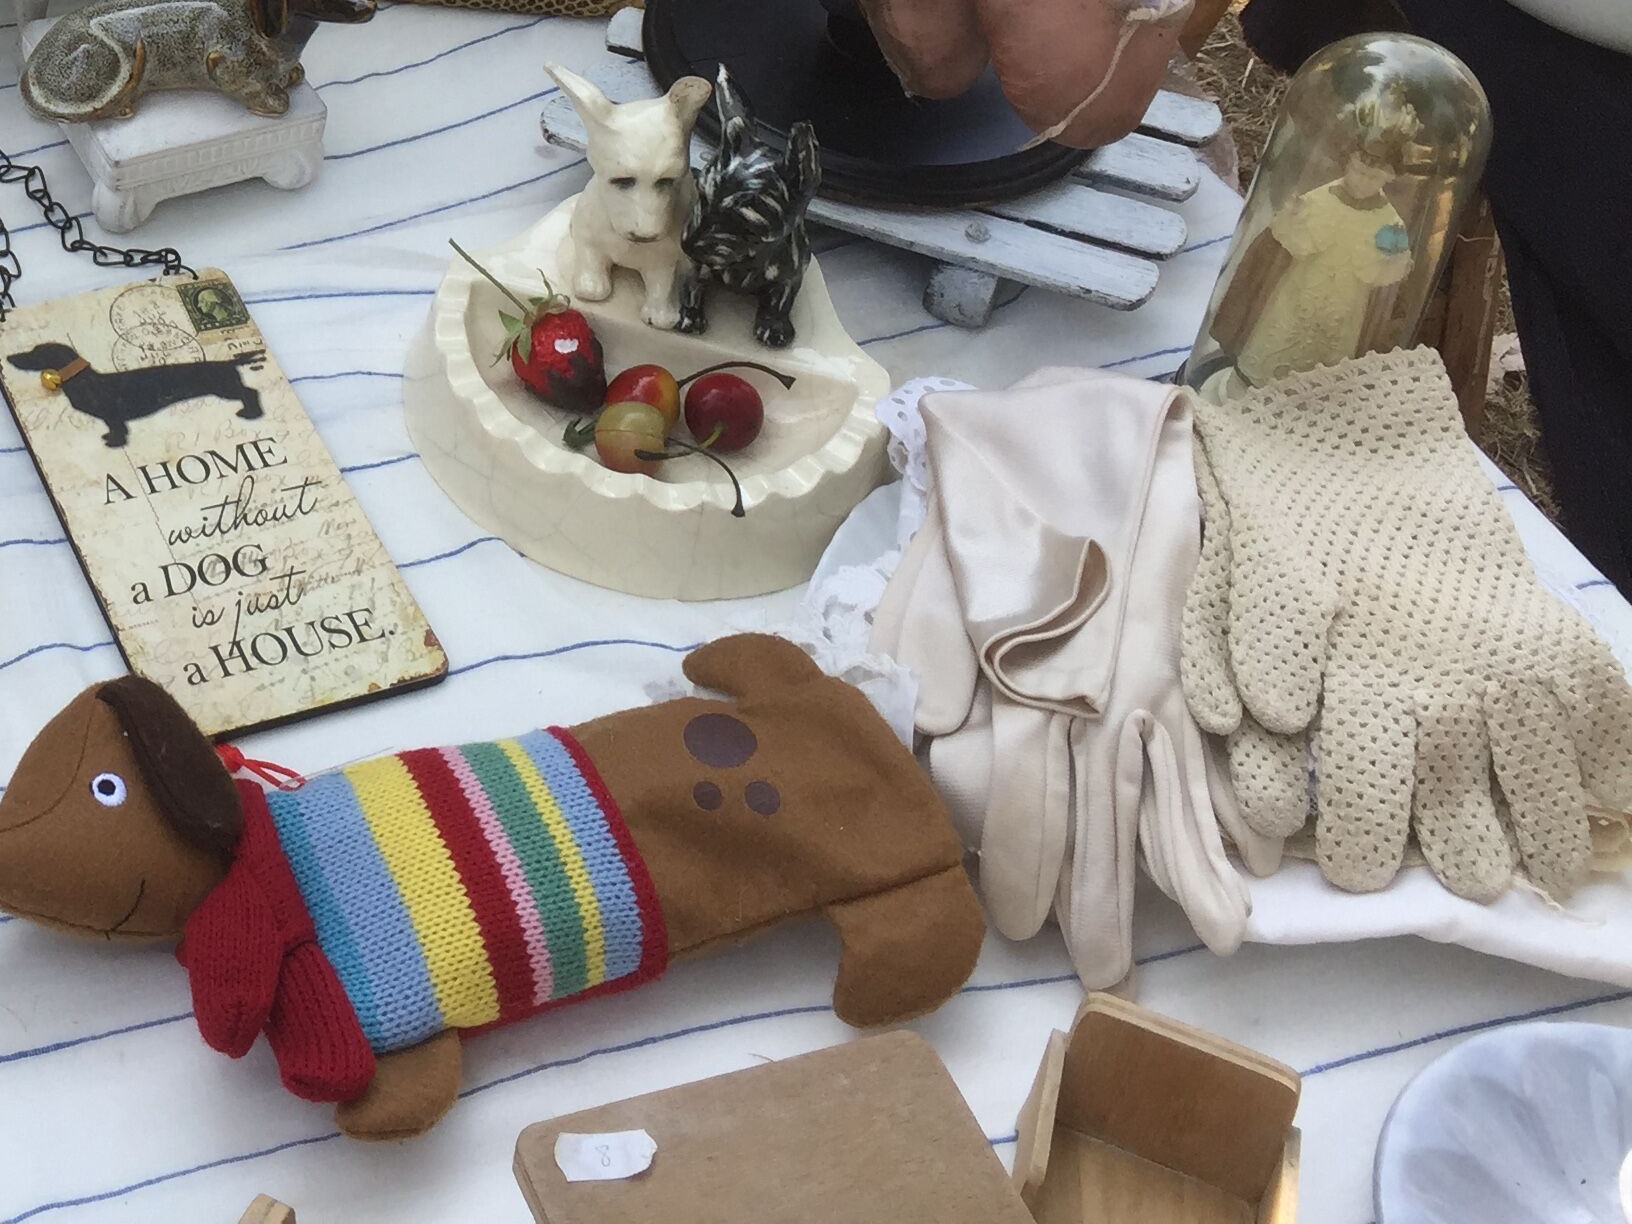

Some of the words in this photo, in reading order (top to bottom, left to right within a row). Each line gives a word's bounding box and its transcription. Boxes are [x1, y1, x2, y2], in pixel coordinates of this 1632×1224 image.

[104, 473, 138, 505] A
[137, 437, 288, 495] HOME
[168, 475, 322, 546] without
[130, 581, 153, 605] a
[158, 544, 269, 599] DOG
[183, 661, 209, 686] a
[208, 608, 395, 678] HOUSE.
[192, 606, 225, 628] is
[228, 566, 307, 657] just
